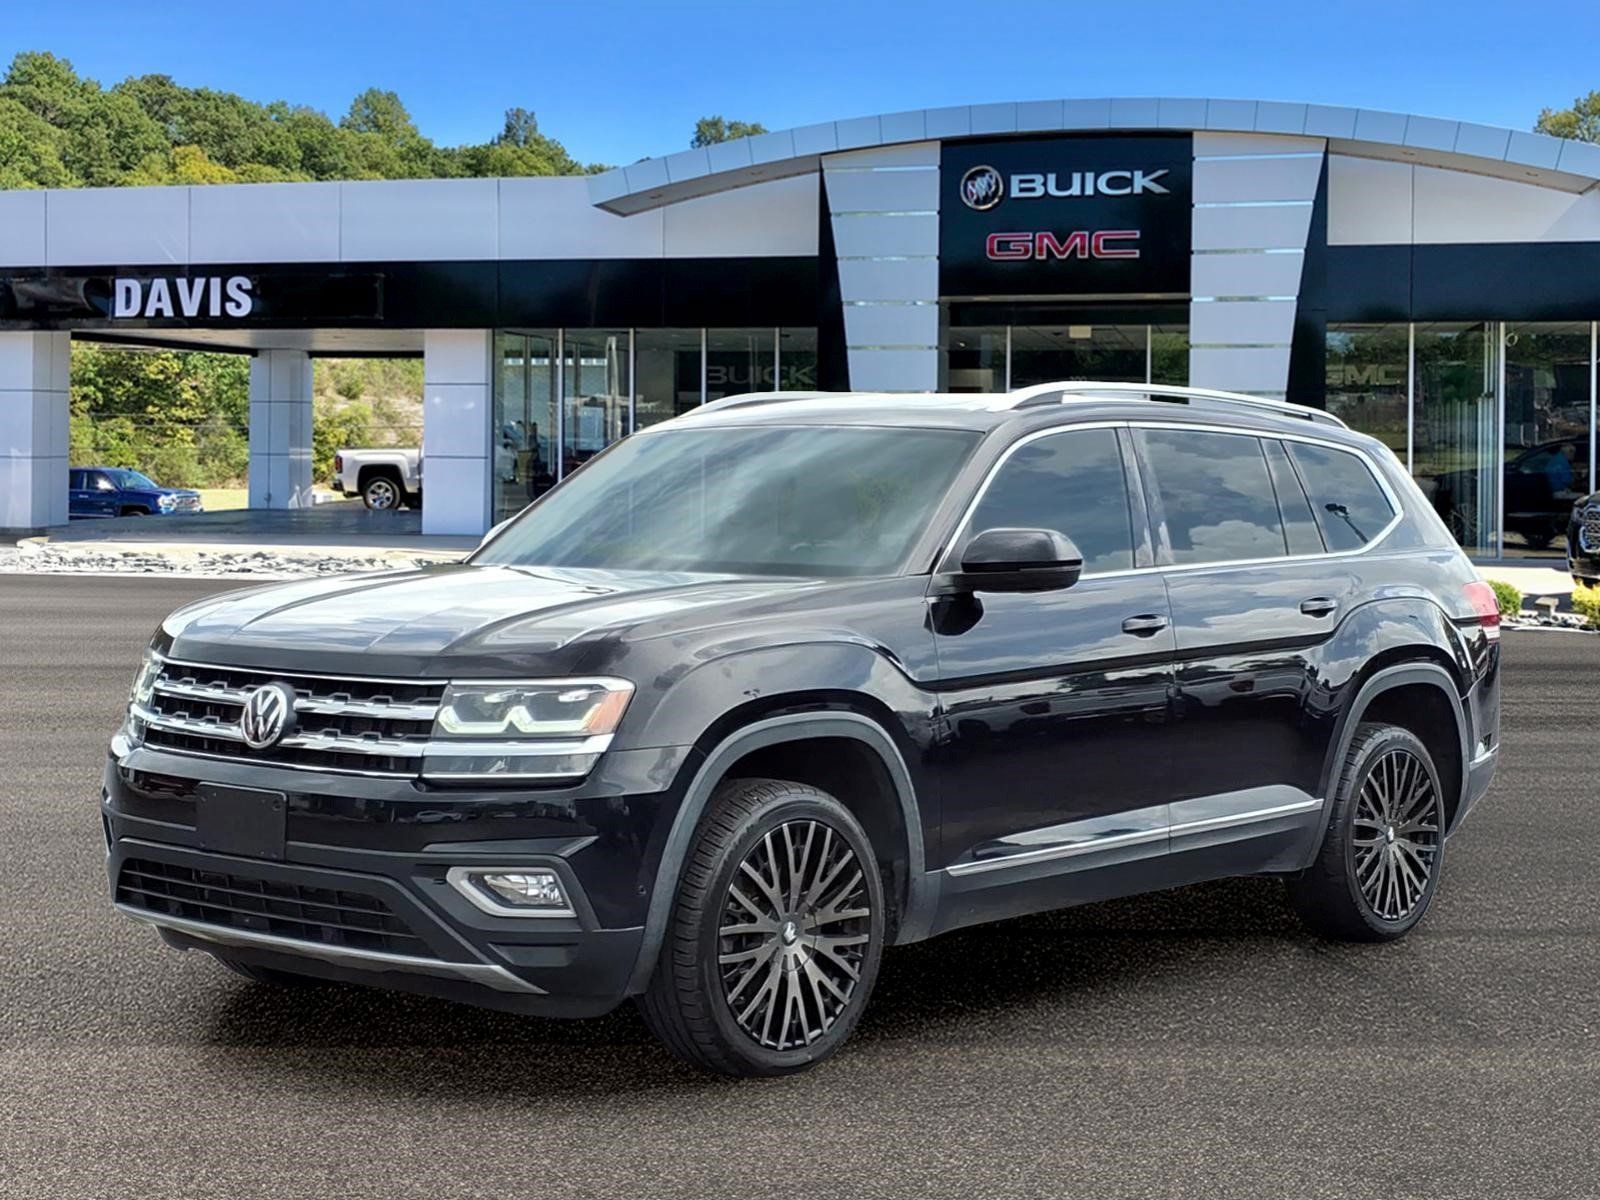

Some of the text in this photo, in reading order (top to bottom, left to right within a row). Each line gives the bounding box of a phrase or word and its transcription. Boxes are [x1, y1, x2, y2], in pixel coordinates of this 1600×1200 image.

[1010, 169, 1170, 198] BUICK
[986, 230, 1140, 260] GMC
[114, 276, 252, 318] DAVIS
